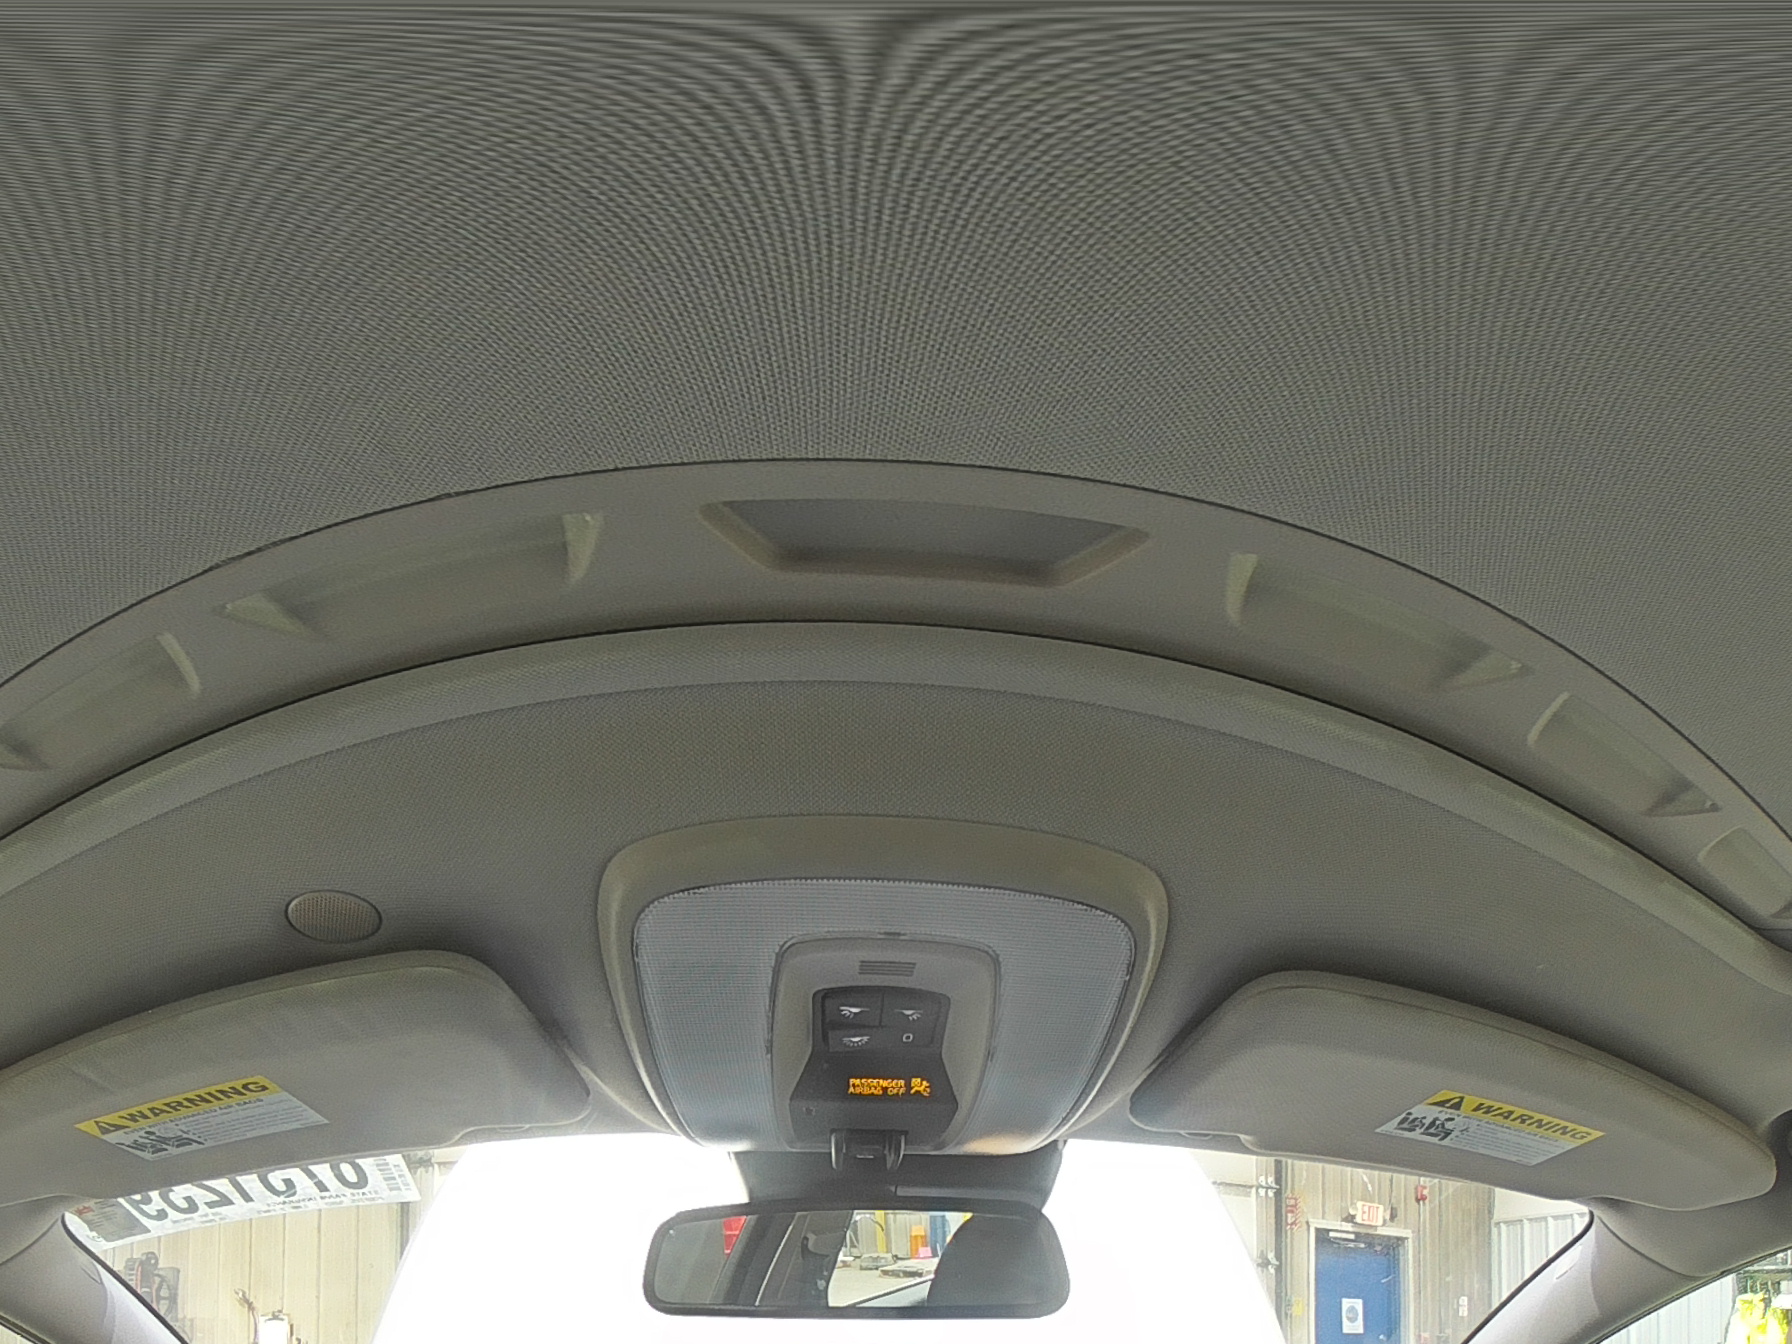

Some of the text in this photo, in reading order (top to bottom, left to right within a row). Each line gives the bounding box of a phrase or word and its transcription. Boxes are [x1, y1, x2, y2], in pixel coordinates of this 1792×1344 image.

[848, 1087, 906, 1096] AIRBAG OFF
[849, 1078, 905, 1088] PASSENGER
[118, 1081, 269, 1123] WARNING
[1471, 1103, 1592, 1141] WARNING
[1361, 1203, 1380, 1224] EXIT
